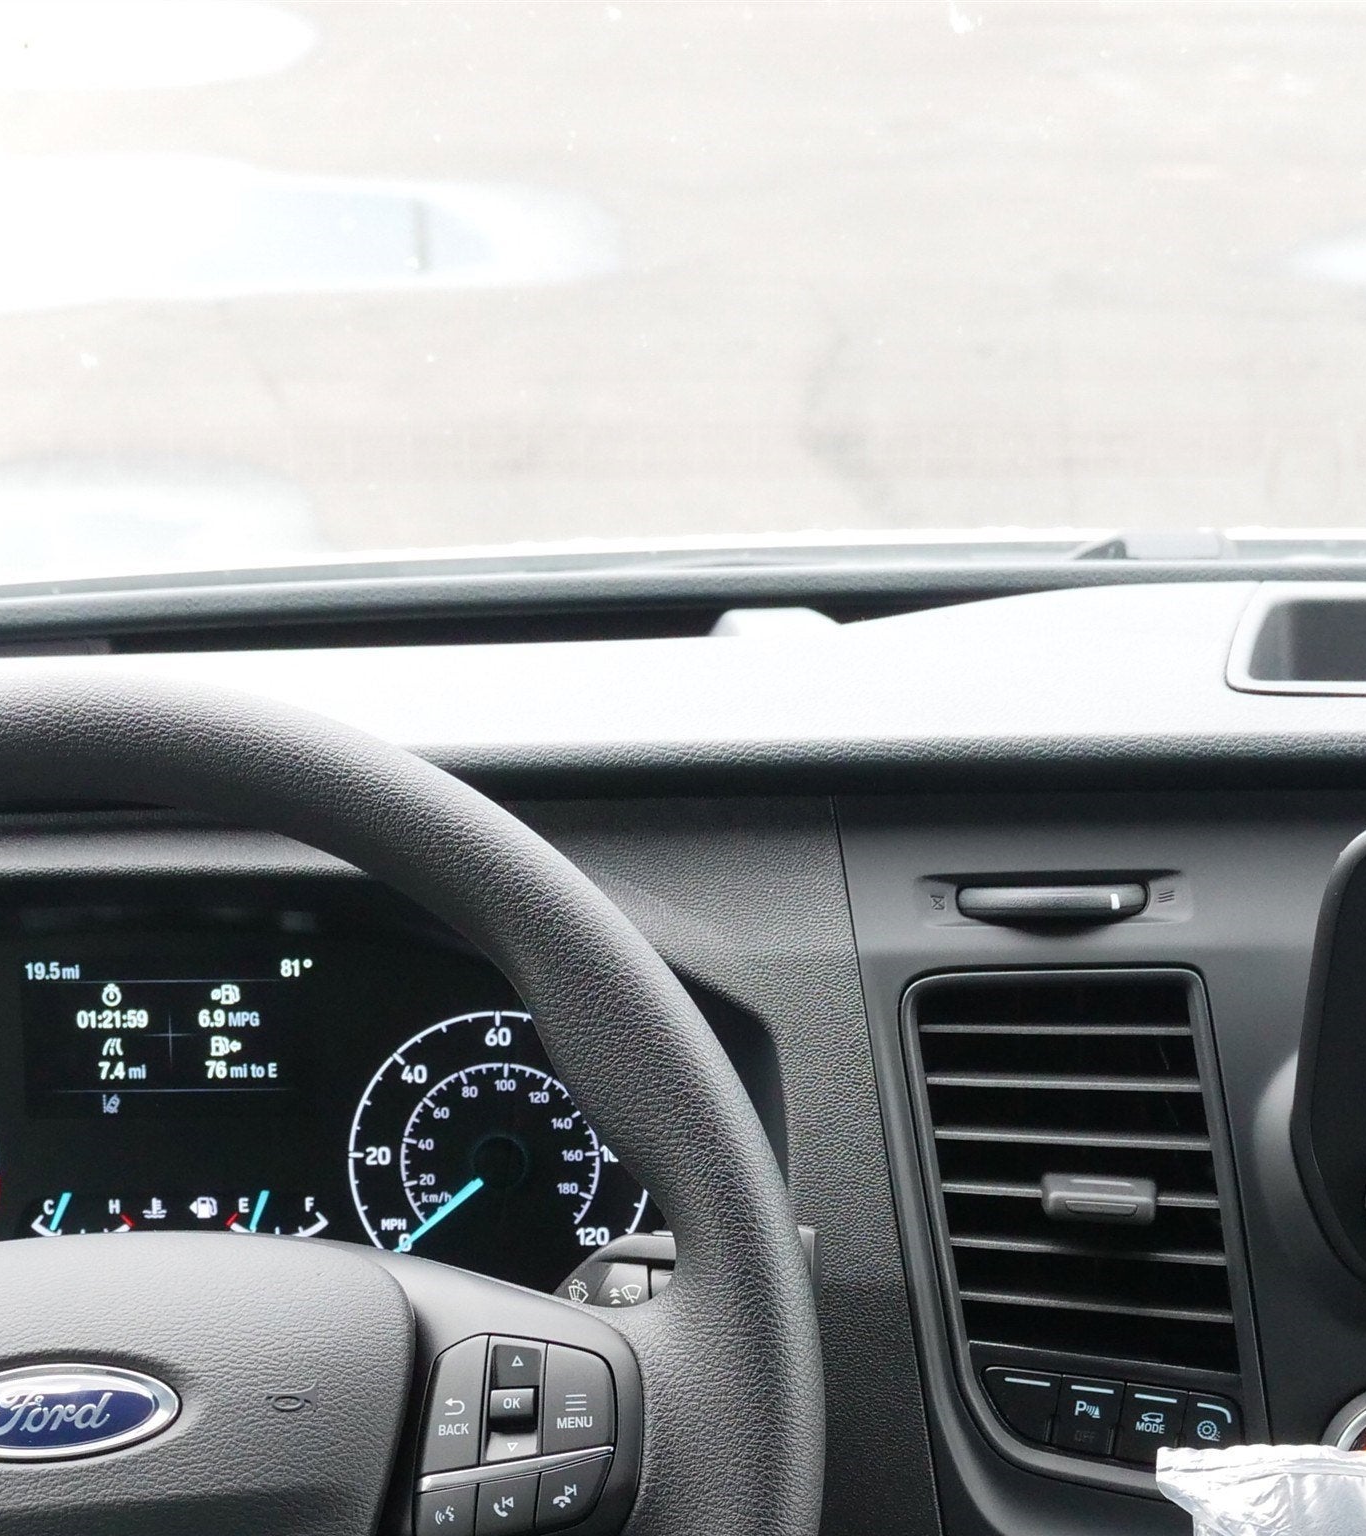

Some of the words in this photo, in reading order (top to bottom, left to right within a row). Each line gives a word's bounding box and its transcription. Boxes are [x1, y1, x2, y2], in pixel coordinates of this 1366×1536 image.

[76, 1010, 149, 1030] 01:21:59
[198, 1009, 226, 1028] 6.9
[228, 1011, 260, 1028] MPG
[485, 1027, 512, 1047] 60
[98, 1061, 126, 1080] 7.4
[128, 1064, 147, 1080] mi
[205, 1060, 228, 1080] 76
[230, 1064, 248, 1079] mi
[250, 1064, 265, 1078] to
[267, 1063, 278, 1078] E
[401, 1064, 428, 1084] 40
[462, 1085, 479, 1099] 80
[494, 1079, 516, 1092] 100
[528, 1091, 550, 1104] 120
[433, 1106, 450, 1120] 60
[551, 1117, 573, 1131] 140
[418, 1138, 435, 1151] 40
[365, 1146, 392, 1166] 20
[561, 1149, 584, 1162] 160
[419, 1173, 436, 1186] 20
[557, 1182, 579, 1195] 180
[304, 1196, 315, 1211] F
[421, 1191, 453, 1203] km/h
[43, 1199, 55, 1215] C
[108, 1199, 121, 1214] H
[238, 1198, 250, 1213] E
[381, 1218, 407, 1231] MPH
[398, 1233, 412, 1252] 0
[575, 1227, 610, 1247] 120
[503, 1397, 521, 1410] OK
[438, 1422, 469, 1437] BACK
[556, 1416, 593, 1430] MENU
[1135, 1421, 1165, 1435] MODE
